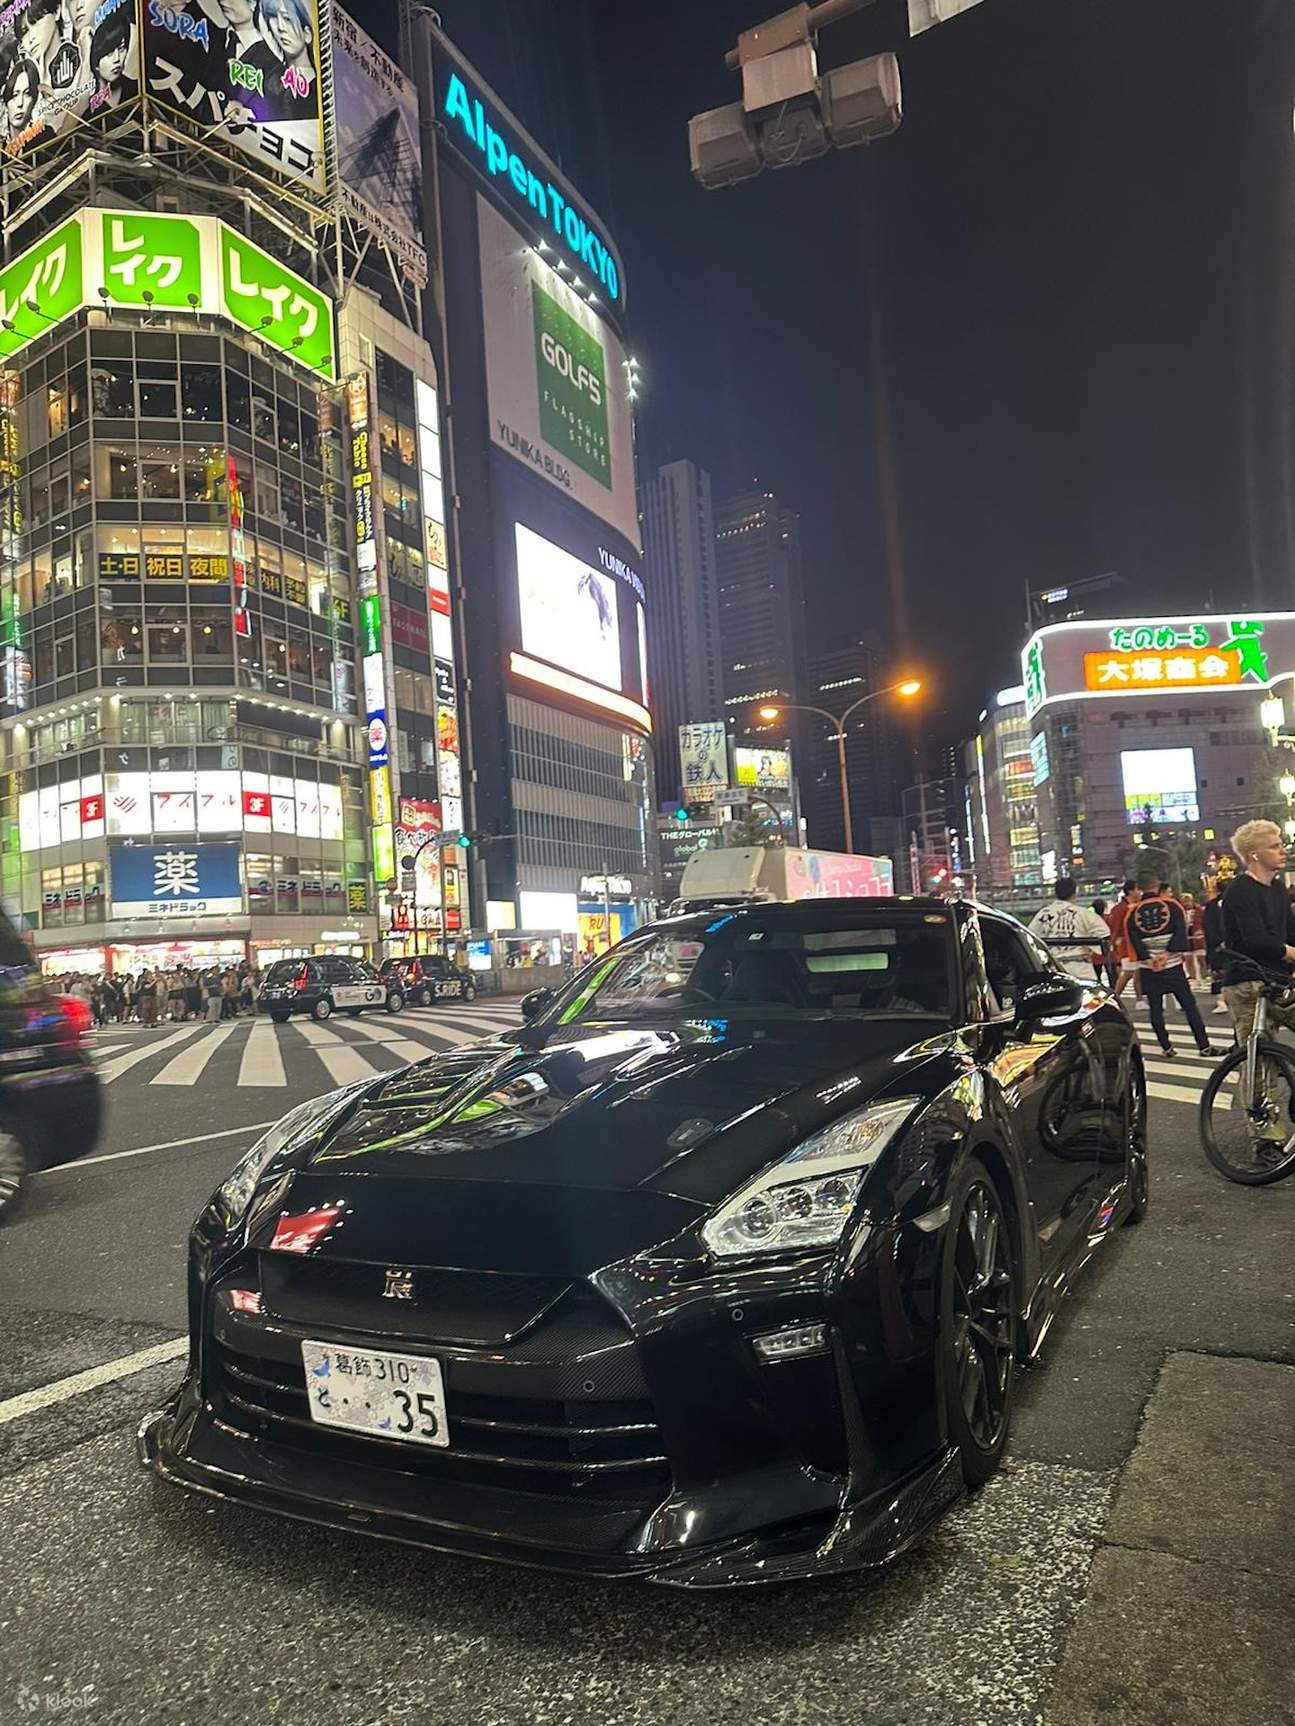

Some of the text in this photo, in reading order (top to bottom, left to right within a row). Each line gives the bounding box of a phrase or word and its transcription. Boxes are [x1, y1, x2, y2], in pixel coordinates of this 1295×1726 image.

[227, 58, 264, 98] REI
[281, 65, 310, 99] AO
[54, 98, 79, 116] GOUP
[230, 247, 318, 337] レイク
[541, 332, 602, 405] GOLF5
[544, 391, 605, 447] FLAGSHIP
[569, 429, 607, 467] STORE
[147, 557, 183, 576] 祝日
[190, 557, 227, 576] 夜間
[1110, 624, 1210, 652] たのめーる
[1097, 655, 1230, 683] 大塚商会
[681, 727, 723, 749] カラオケ
[688, 762, 721, 782] 鉄人
[698, 750, 708, 763] の
[153, 851, 200, 896] 薬
